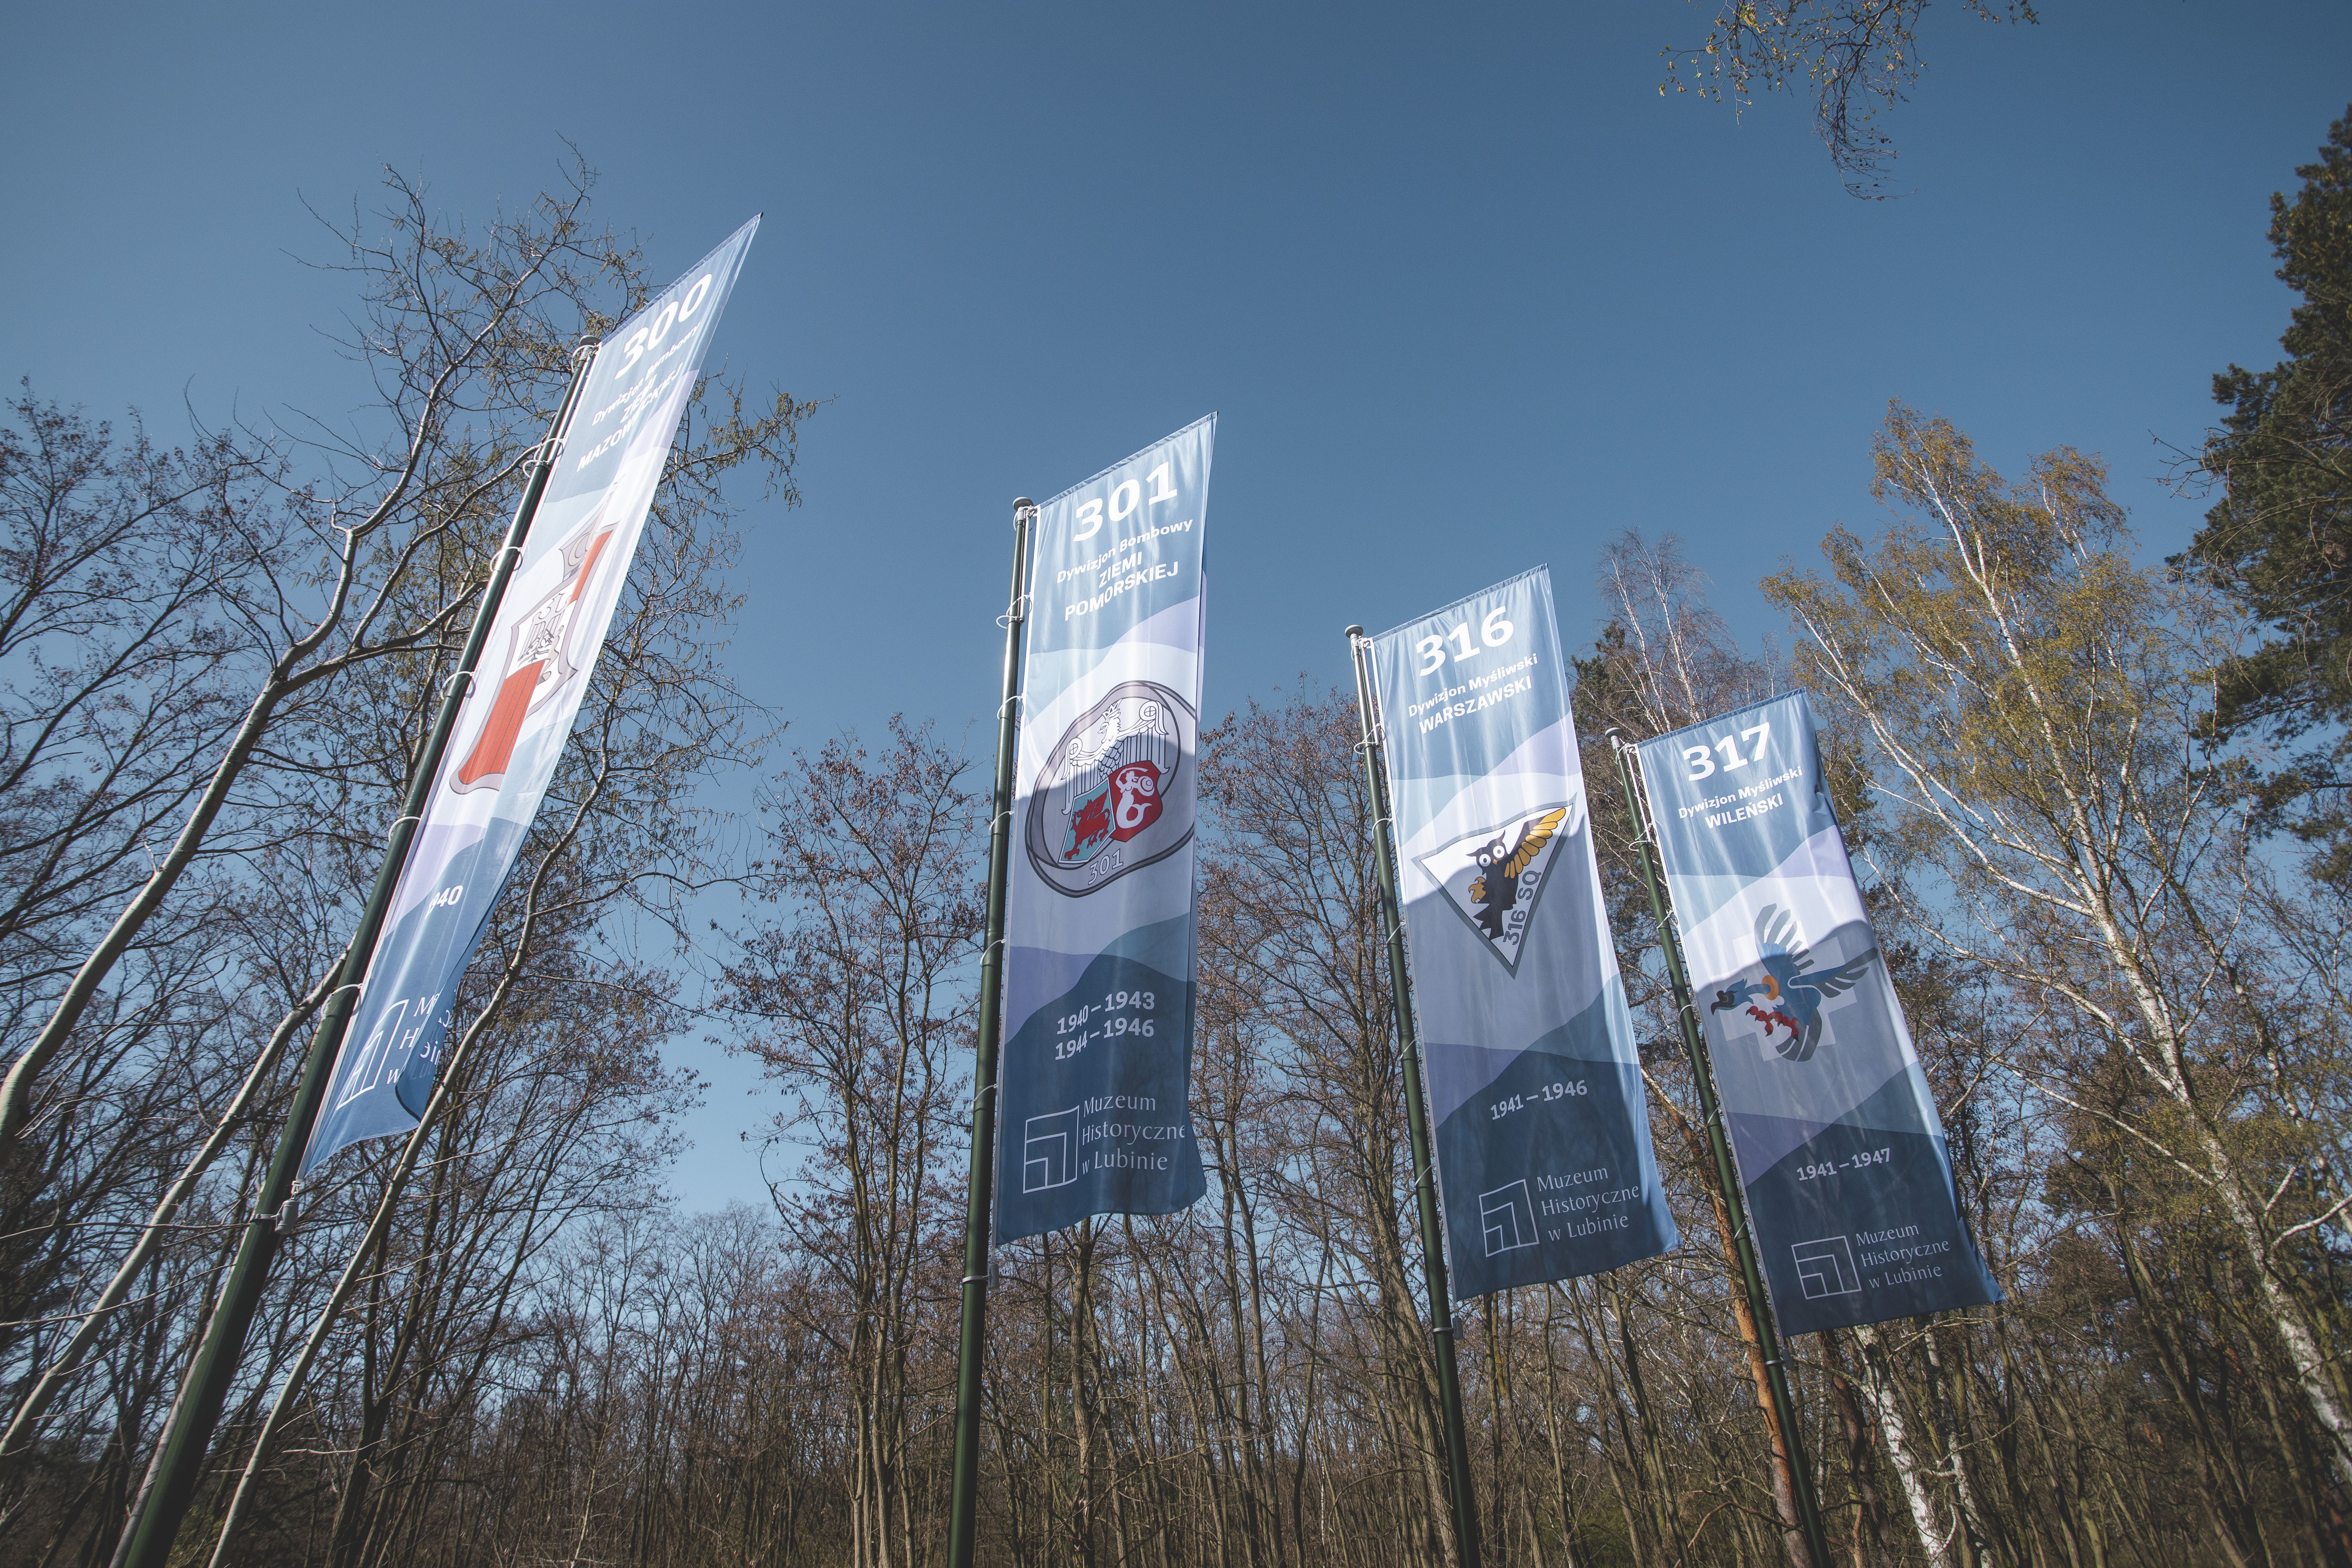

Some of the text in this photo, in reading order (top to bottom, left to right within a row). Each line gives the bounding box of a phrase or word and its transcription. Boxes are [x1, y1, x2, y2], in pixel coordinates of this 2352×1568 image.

[614, 273, 712, 380] 300
[592, 321, 701, 426] Dywizjon Bombowy
[620, 374, 657, 423] ZIEMI
[1073, 461, 1177, 542] 301
[1057, 519, 1193, 583] Dywizjon Bombowy
[1099, 551, 1142, 588] ZIEMI
[1065, 561, 1179, 621] POMORSKIEJ
[1416, 606, 1514, 676] 316
[1408, 653, 1538, 717] Dywizjon Myśliwski
[1419, 675, 1532, 734] WARSZAWSKI
[1682, 722, 1770, 781] 317
[1678, 766, 1802, 819] Dywizjon Myśliwski
[1705, 793, 1784, 829] WILEŃSKI
[1088, 848, 1123, 885] 301
[1503, 871, 1541, 945] 316 SQ
[1084, 1096, 1156, 1118] Muzeum
[1083, 1121, 1185, 1145] Historyczne
[1083, 1148, 1168, 1174] w Lubinie
[1537, 1168, 1608, 1191] Muzeum
[1541, 1186, 1639, 1216] Historyczne
[1548, 1214, 1629, 1241] w Lubinie
[1856, 1225, 1919, 1246] Muzeum
[1860, 1240, 1950, 1267] Historyczne
[1869, 1265, 1942, 1288] w Lubinie
